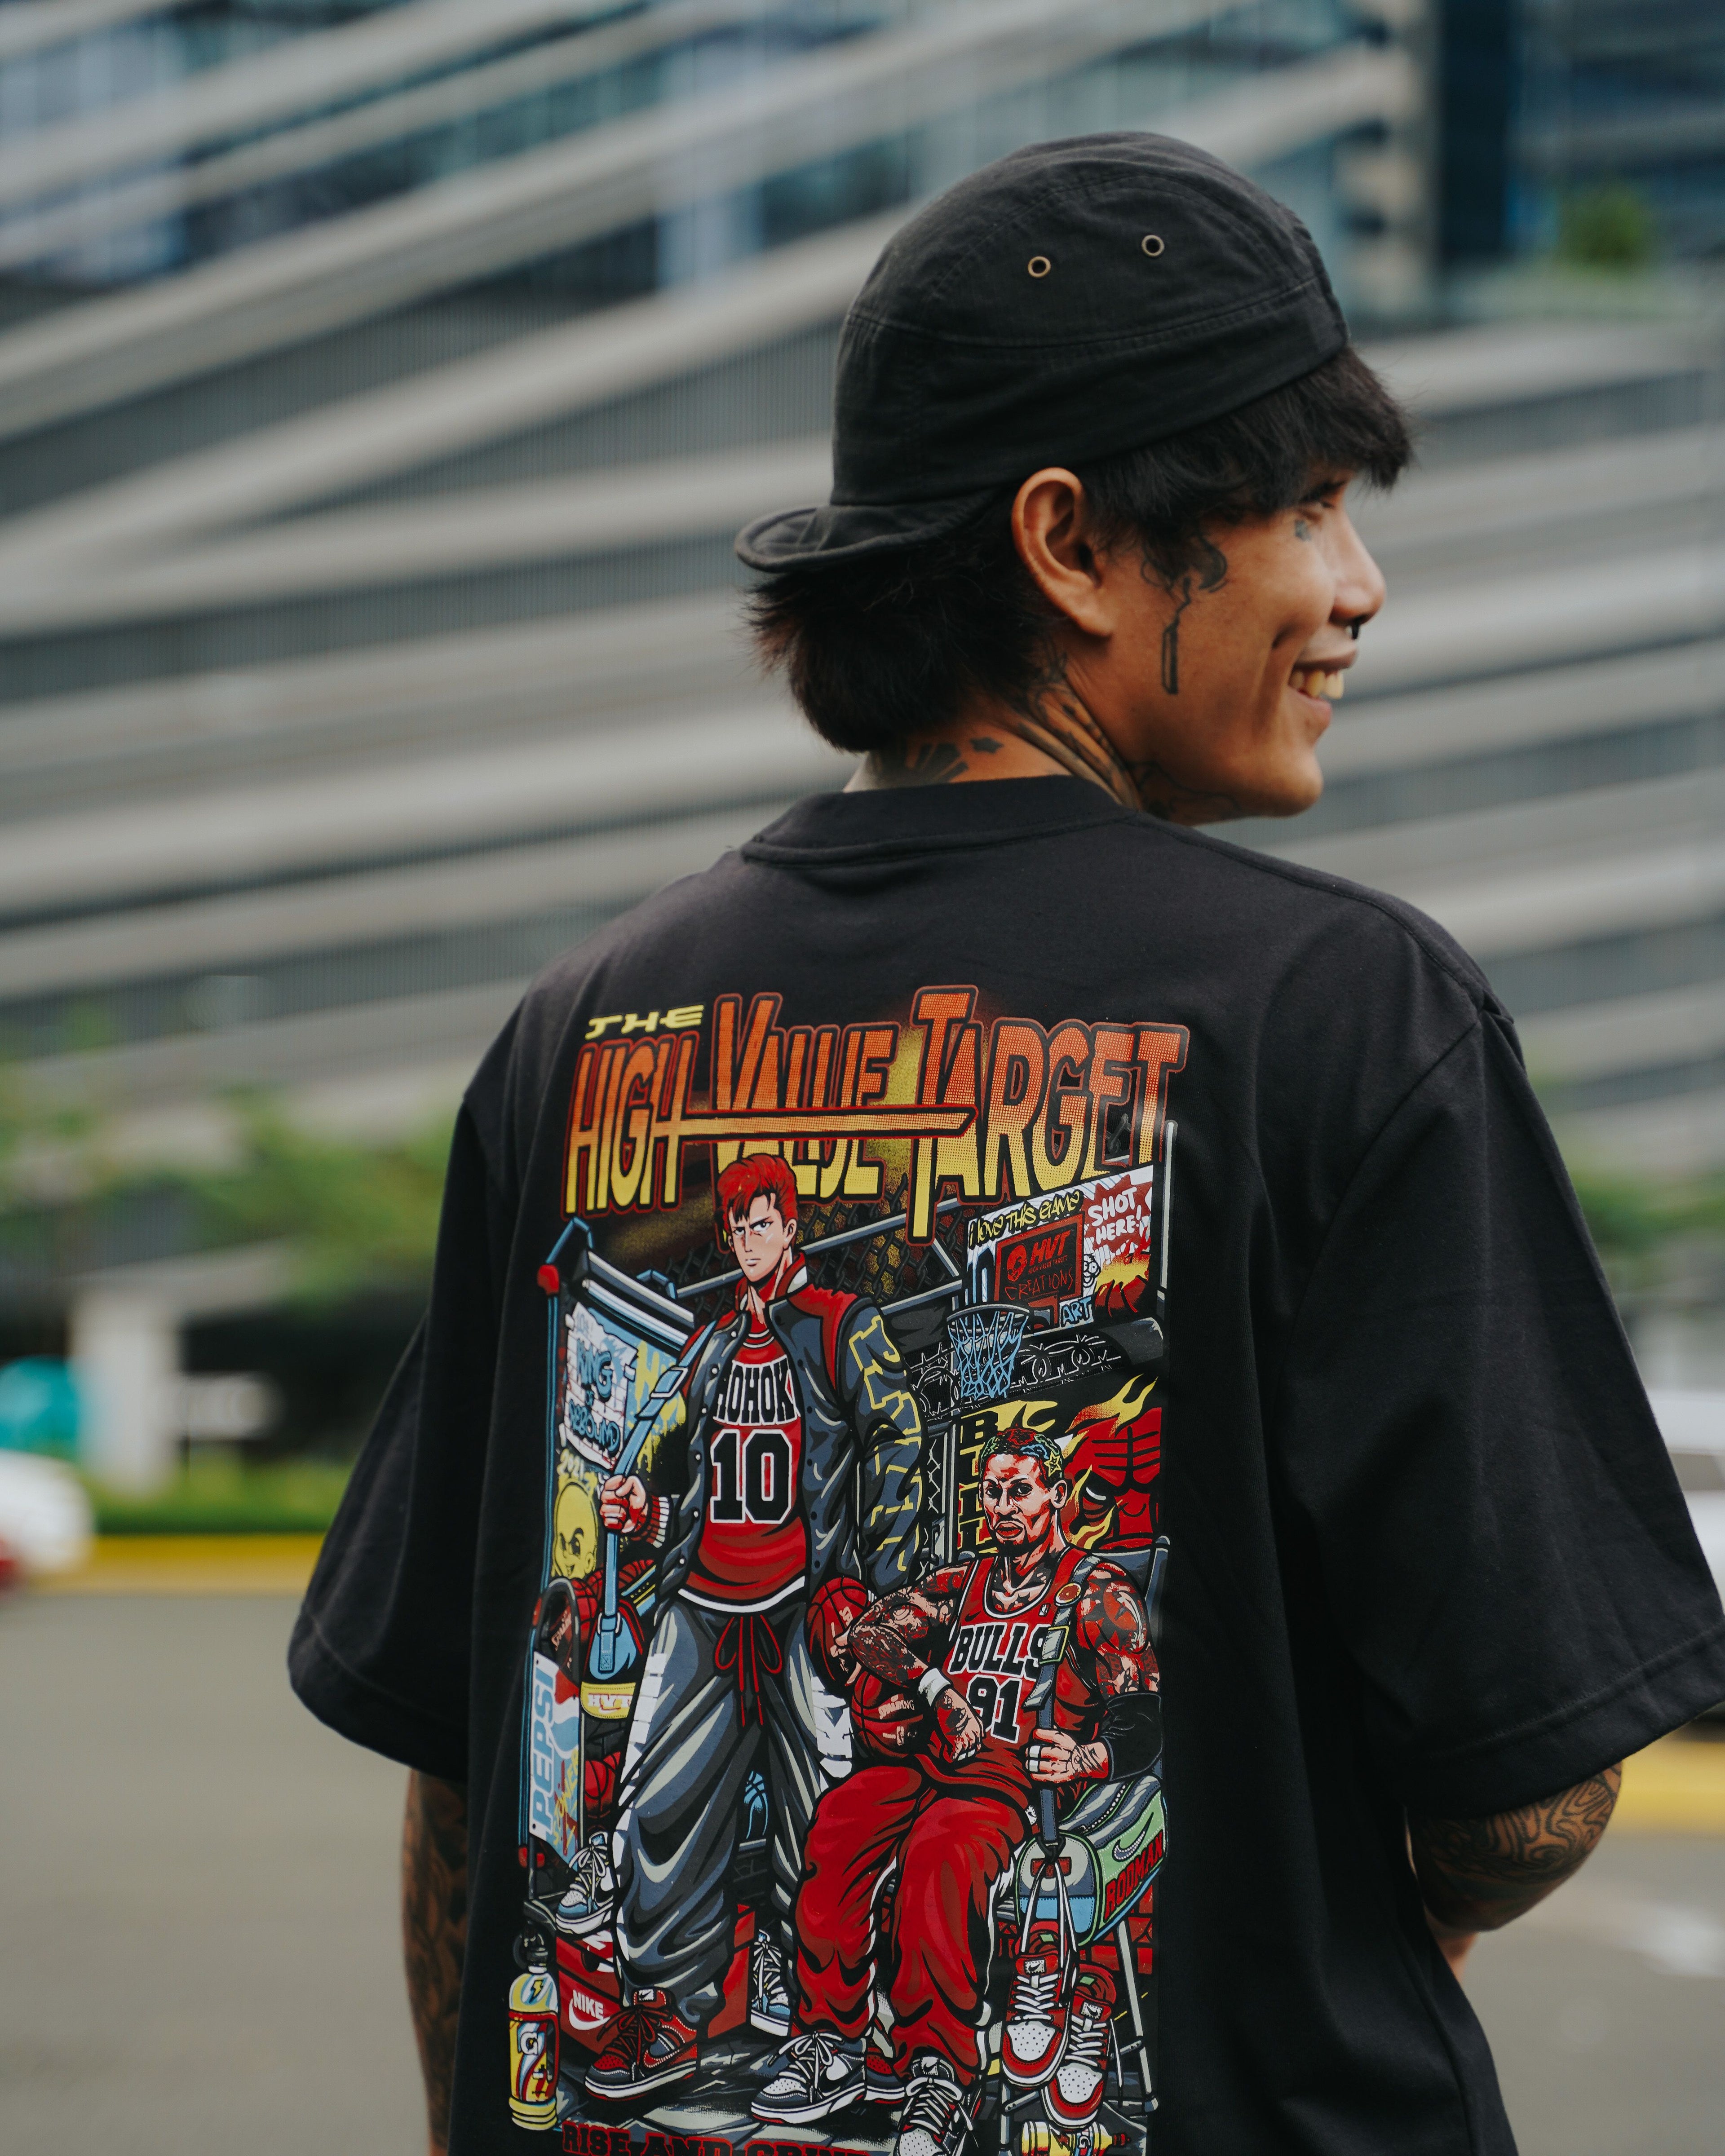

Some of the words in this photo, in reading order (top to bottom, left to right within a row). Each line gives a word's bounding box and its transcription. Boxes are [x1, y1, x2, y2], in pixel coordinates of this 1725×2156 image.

[585, 1005, 704, 1040] THE
[562, 1033, 697, 1218] HIGH
[711, 993, 901, 1206] VALUE
[907, 986, 1190, 1245] TARGET
[1088, 1186, 1138, 1227] SHOT
[1095, 1204, 1142, 1245] HERE!
[1029, 1229, 1071, 1267] HVT
[1004, 1266, 1074, 1301] CREATIONS
[1060, 1296, 1092, 1325] ART
[710, 1428, 792, 1524] 10
[966, 1674, 1022, 1744] 91
[532, 1666, 554, 1834] PEPSI
[1104, 1831, 1163, 1920] RODMAN
[572, 1989, 605, 2020] NIKE
[562, 2120, 631, 2156] RISE
